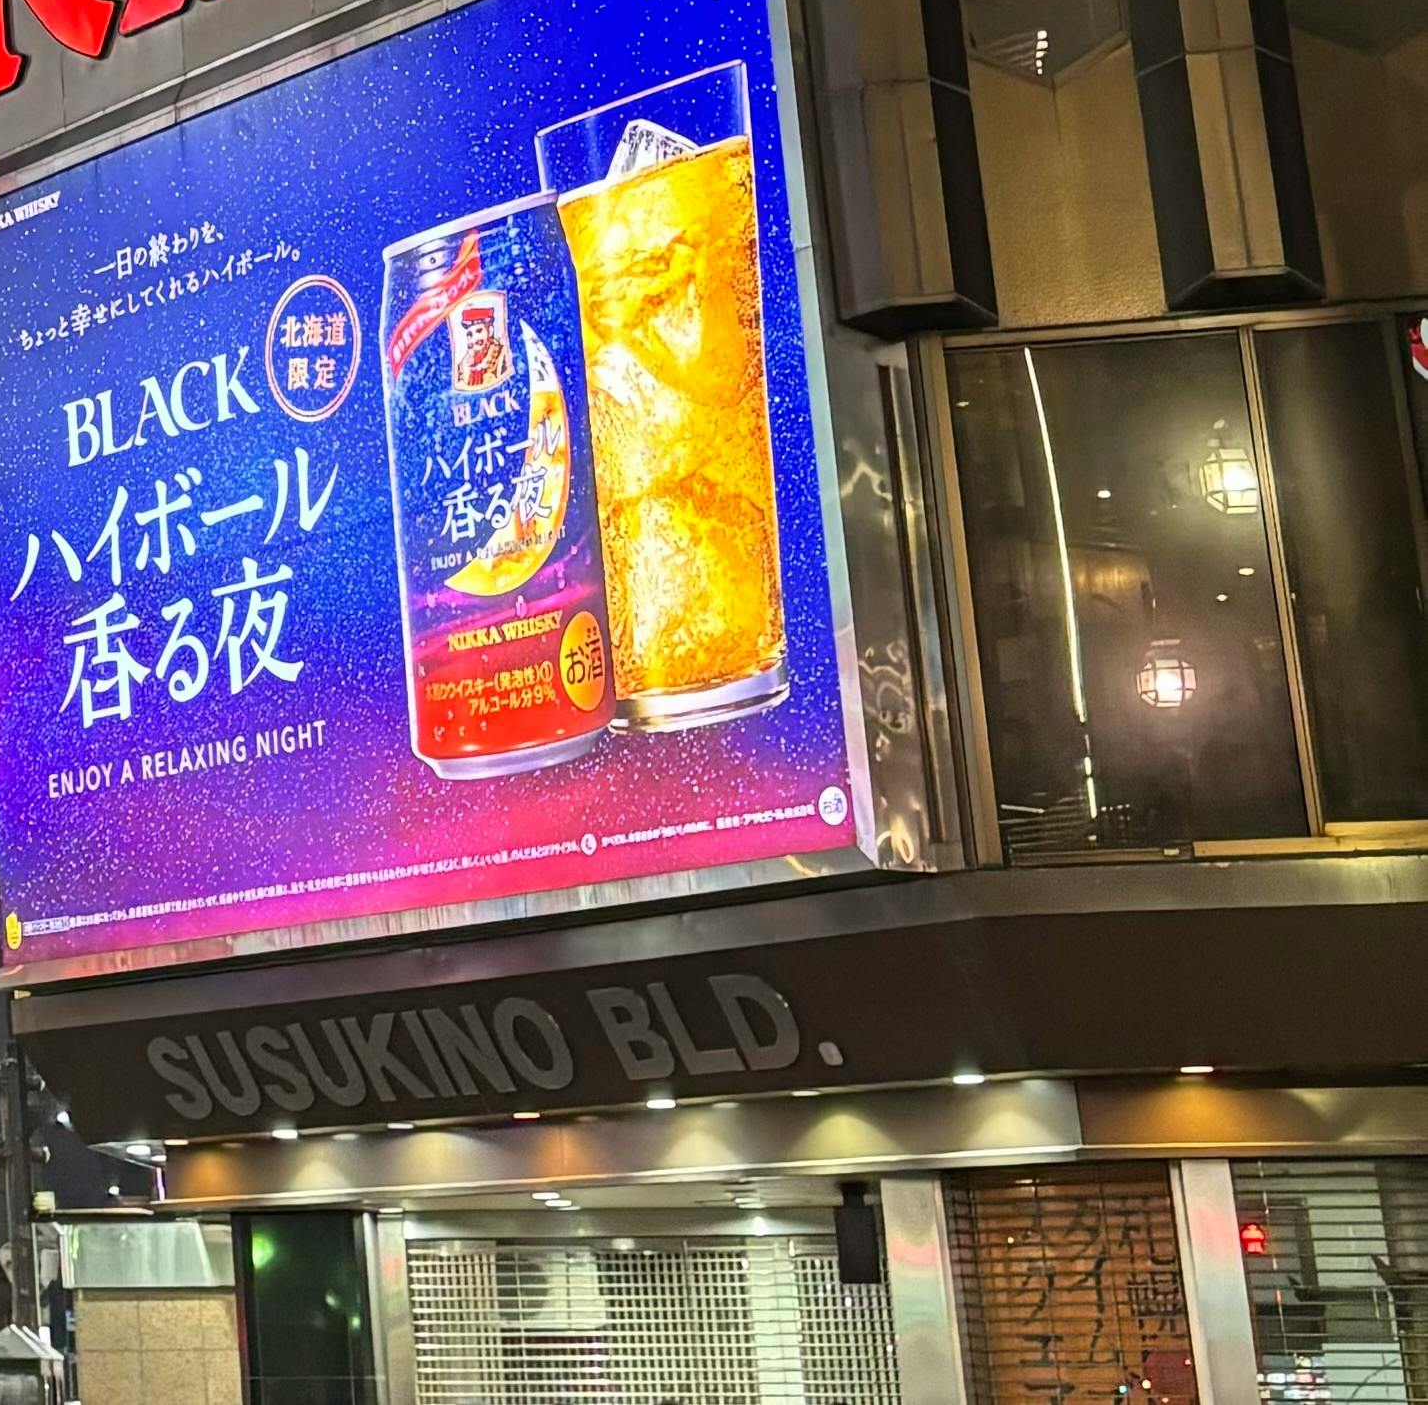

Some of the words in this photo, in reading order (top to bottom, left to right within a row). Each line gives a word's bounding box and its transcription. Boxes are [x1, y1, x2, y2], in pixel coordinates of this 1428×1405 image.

[14, 191, 62, 223] WHISKY
[94, 221, 224, 279] 一日の終わりを、
[20, 242, 300, 351] ちょっと幸せにしてくれるハイボール。
[280, 313, 347, 348] 北海道
[62, 346, 261, 468] BLACK
[287, 356, 337, 391] 限定
[453, 390, 521, 428] BLACK
[421, 419, 562, 487] ハイボール
[10, 449, 340, 602] ハイボール
[440, 464, 552, 543] 香る夜
[59, 559, 305, 731] 香る夜
[448, 626, 501, 653] NIKKA
[502, 610, 563, 640] WHISKY
[565, 637, 603, 685] お酒
[48, 758, 116, 798] ENJOY
[122, 756, 136, 782] A
[141, 735, 250, 781] RELAXING
[255, 720, 326, 760] NIGHT
[147, 997, 573, 1122] SUSUKINO
[591, 974, 846, 1084] BLD.
